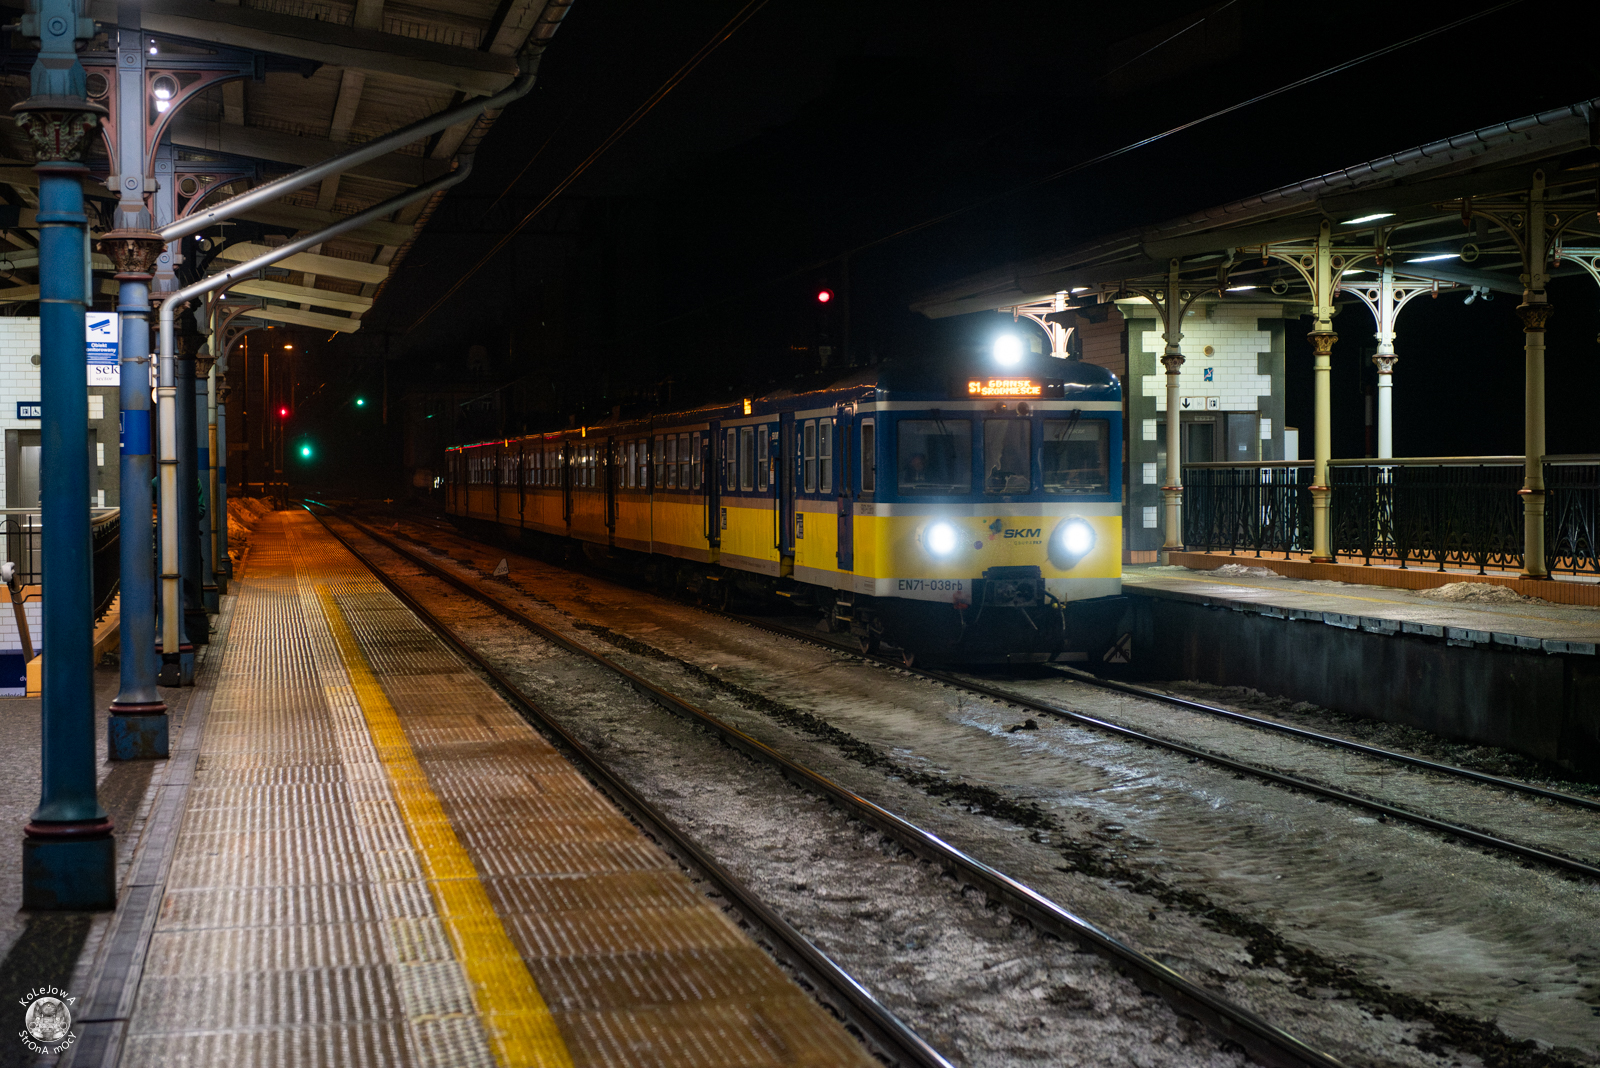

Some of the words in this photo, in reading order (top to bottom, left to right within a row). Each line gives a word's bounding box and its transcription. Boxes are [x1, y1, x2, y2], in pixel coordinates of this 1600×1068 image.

[95, 364, 120, 375] sek
[968, 381, 981, 393] S1
[1003, 528, 1042, 539] SKM
[898, 579, 963, 591] EN71-038rb
